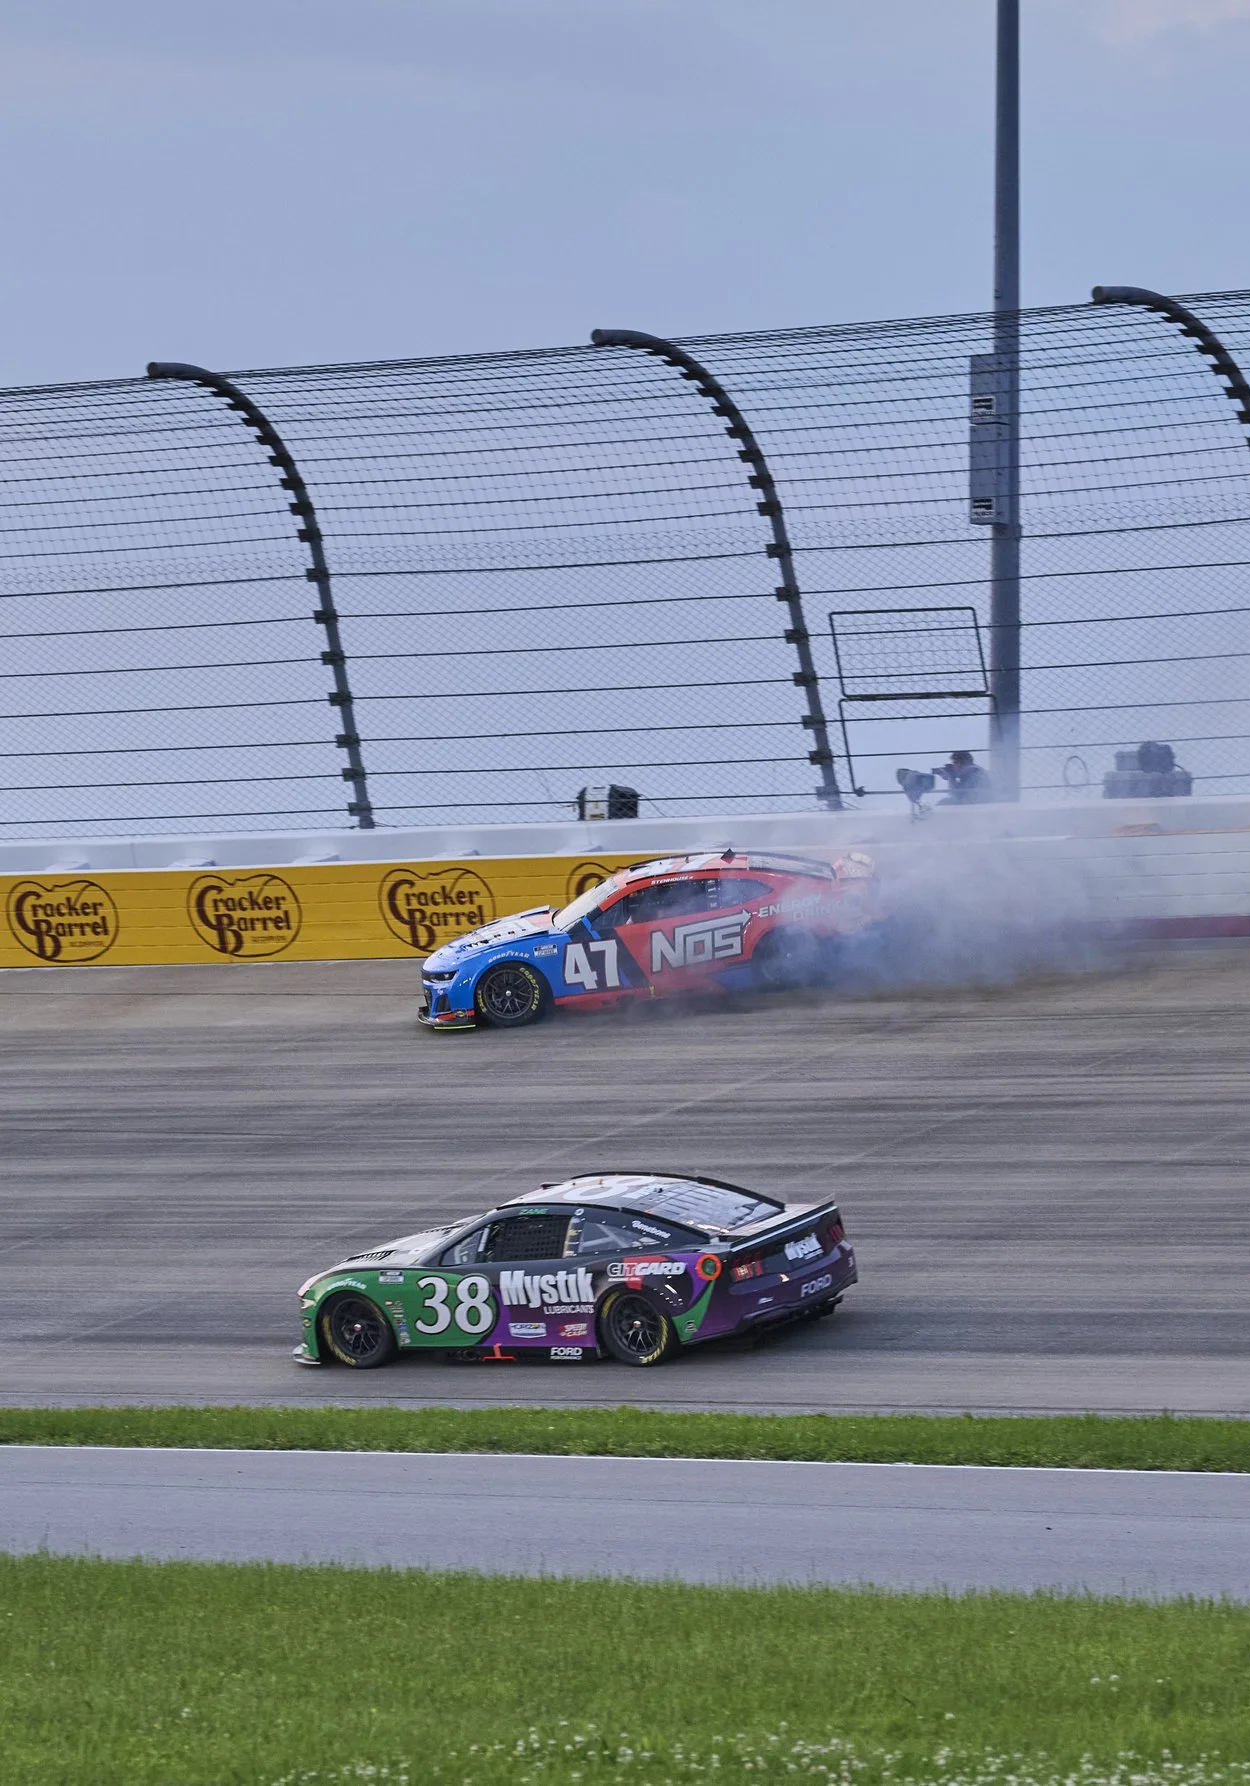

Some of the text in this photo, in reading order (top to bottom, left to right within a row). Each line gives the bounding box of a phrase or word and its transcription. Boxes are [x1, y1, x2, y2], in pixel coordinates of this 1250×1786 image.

[15, 890, 104, 936] Cracker
[195, 885, 287, 930] Cracker
[387, 879, 480, 925] Cracker
[31, 915, 109, 958] Barrel
[213, 910, 292, 953] Barrel
[406, 905, 485, 950] Barrel
[651, 913, 748, 972] NOS
[488, 950, 530, 963] GOODYEAR
[564, 939, 620, 990] 47
[519, 967, 540, 1011] GOODYEAR
[500, 1267, 596, 1308] Mystik
[606, 1262, 687, 1277] CITGARD
[800, 1274, 832, 1298] FORD
[415, 1276, 494, 1335] 38
[543, 1304, 595, 1315] LUBRICANTS
[550, 1346, 583, 1356] FORD
